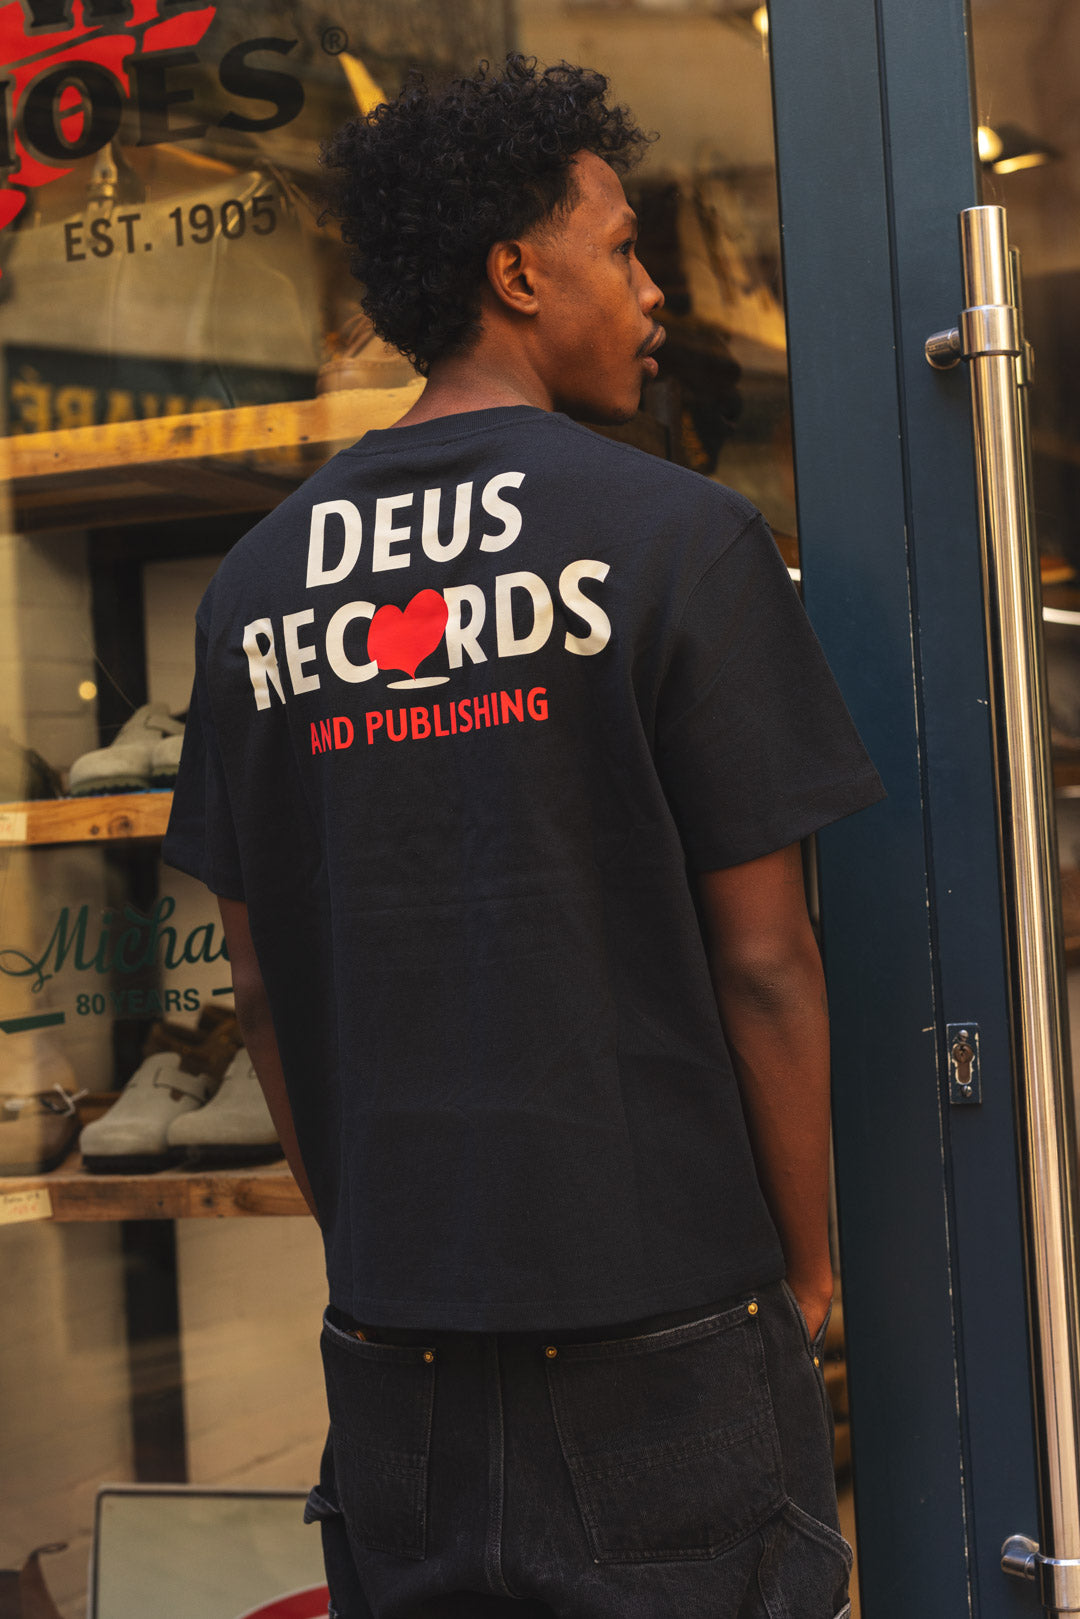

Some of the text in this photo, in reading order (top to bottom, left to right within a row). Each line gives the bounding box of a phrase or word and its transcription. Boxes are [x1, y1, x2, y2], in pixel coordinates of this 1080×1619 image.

[0, 37, 305, 169] OES
[64, 195, 278, 262] EST. 1905
[305, 471, 526, 589] DEUS
[310, 686, 549, 755] AND PUBLISHING
[76, 989, 200, 1016] 80 YEARS
